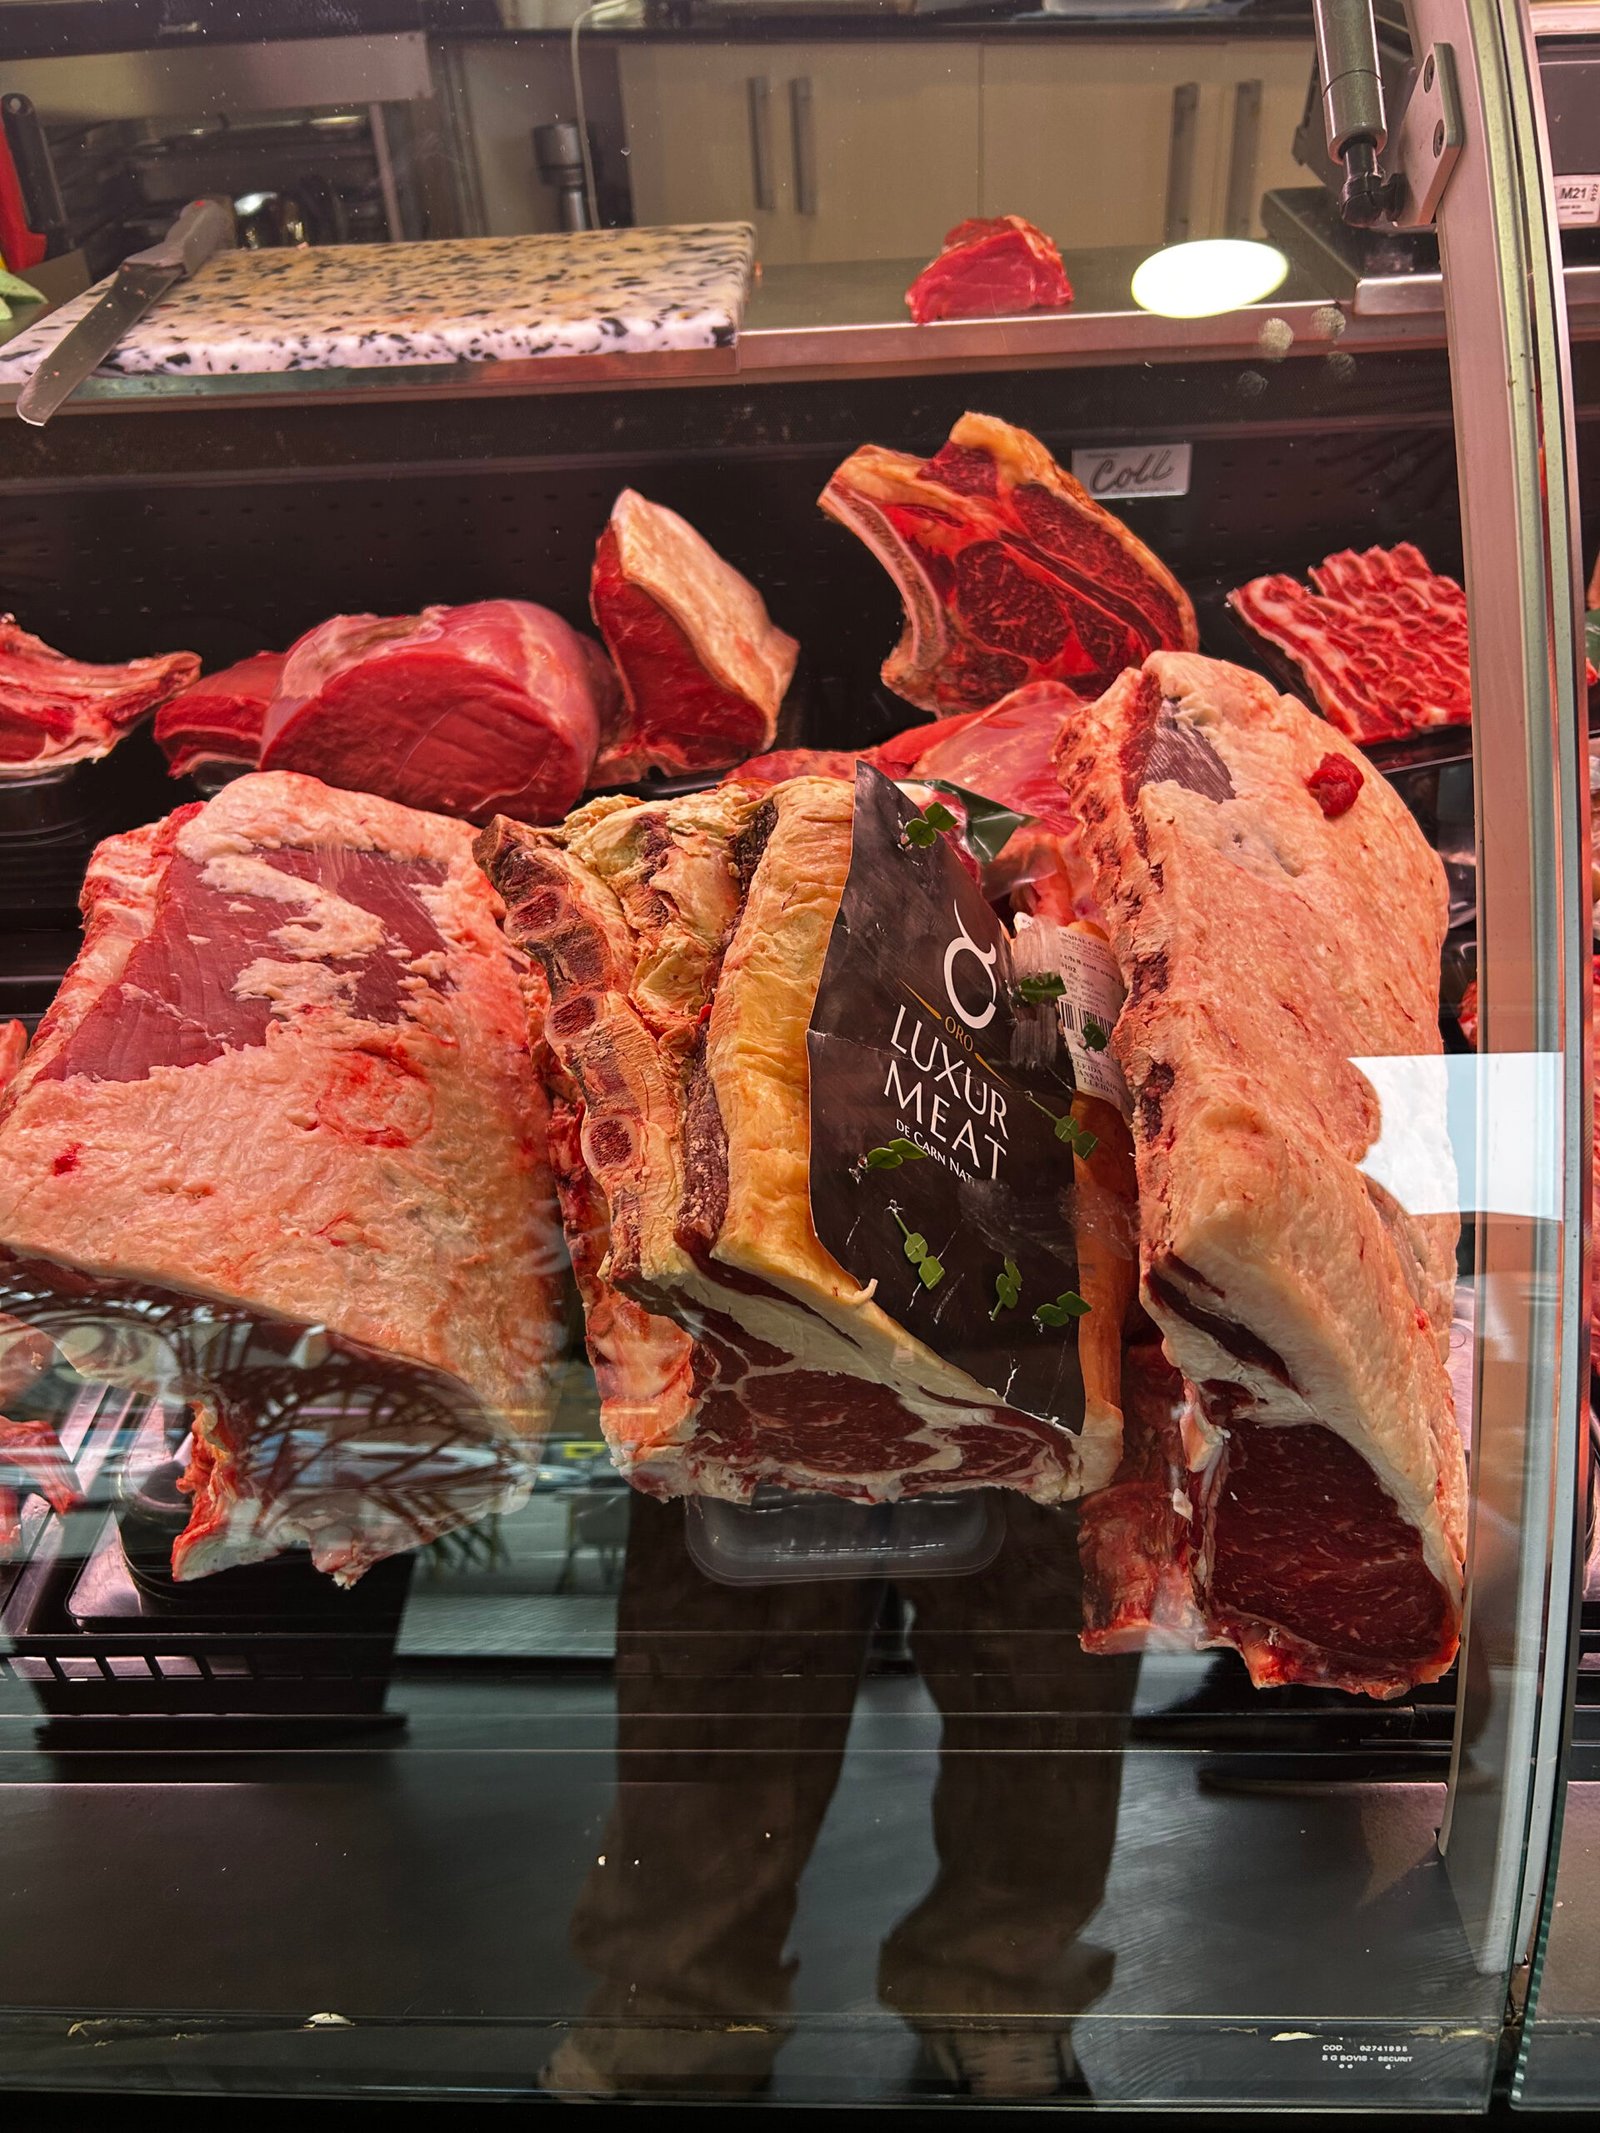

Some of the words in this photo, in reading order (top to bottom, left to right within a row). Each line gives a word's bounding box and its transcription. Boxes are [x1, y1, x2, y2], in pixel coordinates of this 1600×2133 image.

[1560, 187, 1587, 199] M21
[1089, 449, 1173, 493] Coll
[945, 1016, 974, 1052] ORO
[890, 1004, 1009, 1140] LUXUR
[884, 1060, 1007, 1180] MEAT
[896, 1118, 910, 1138] DE
[914, 1131, 946, 1166] CARN
